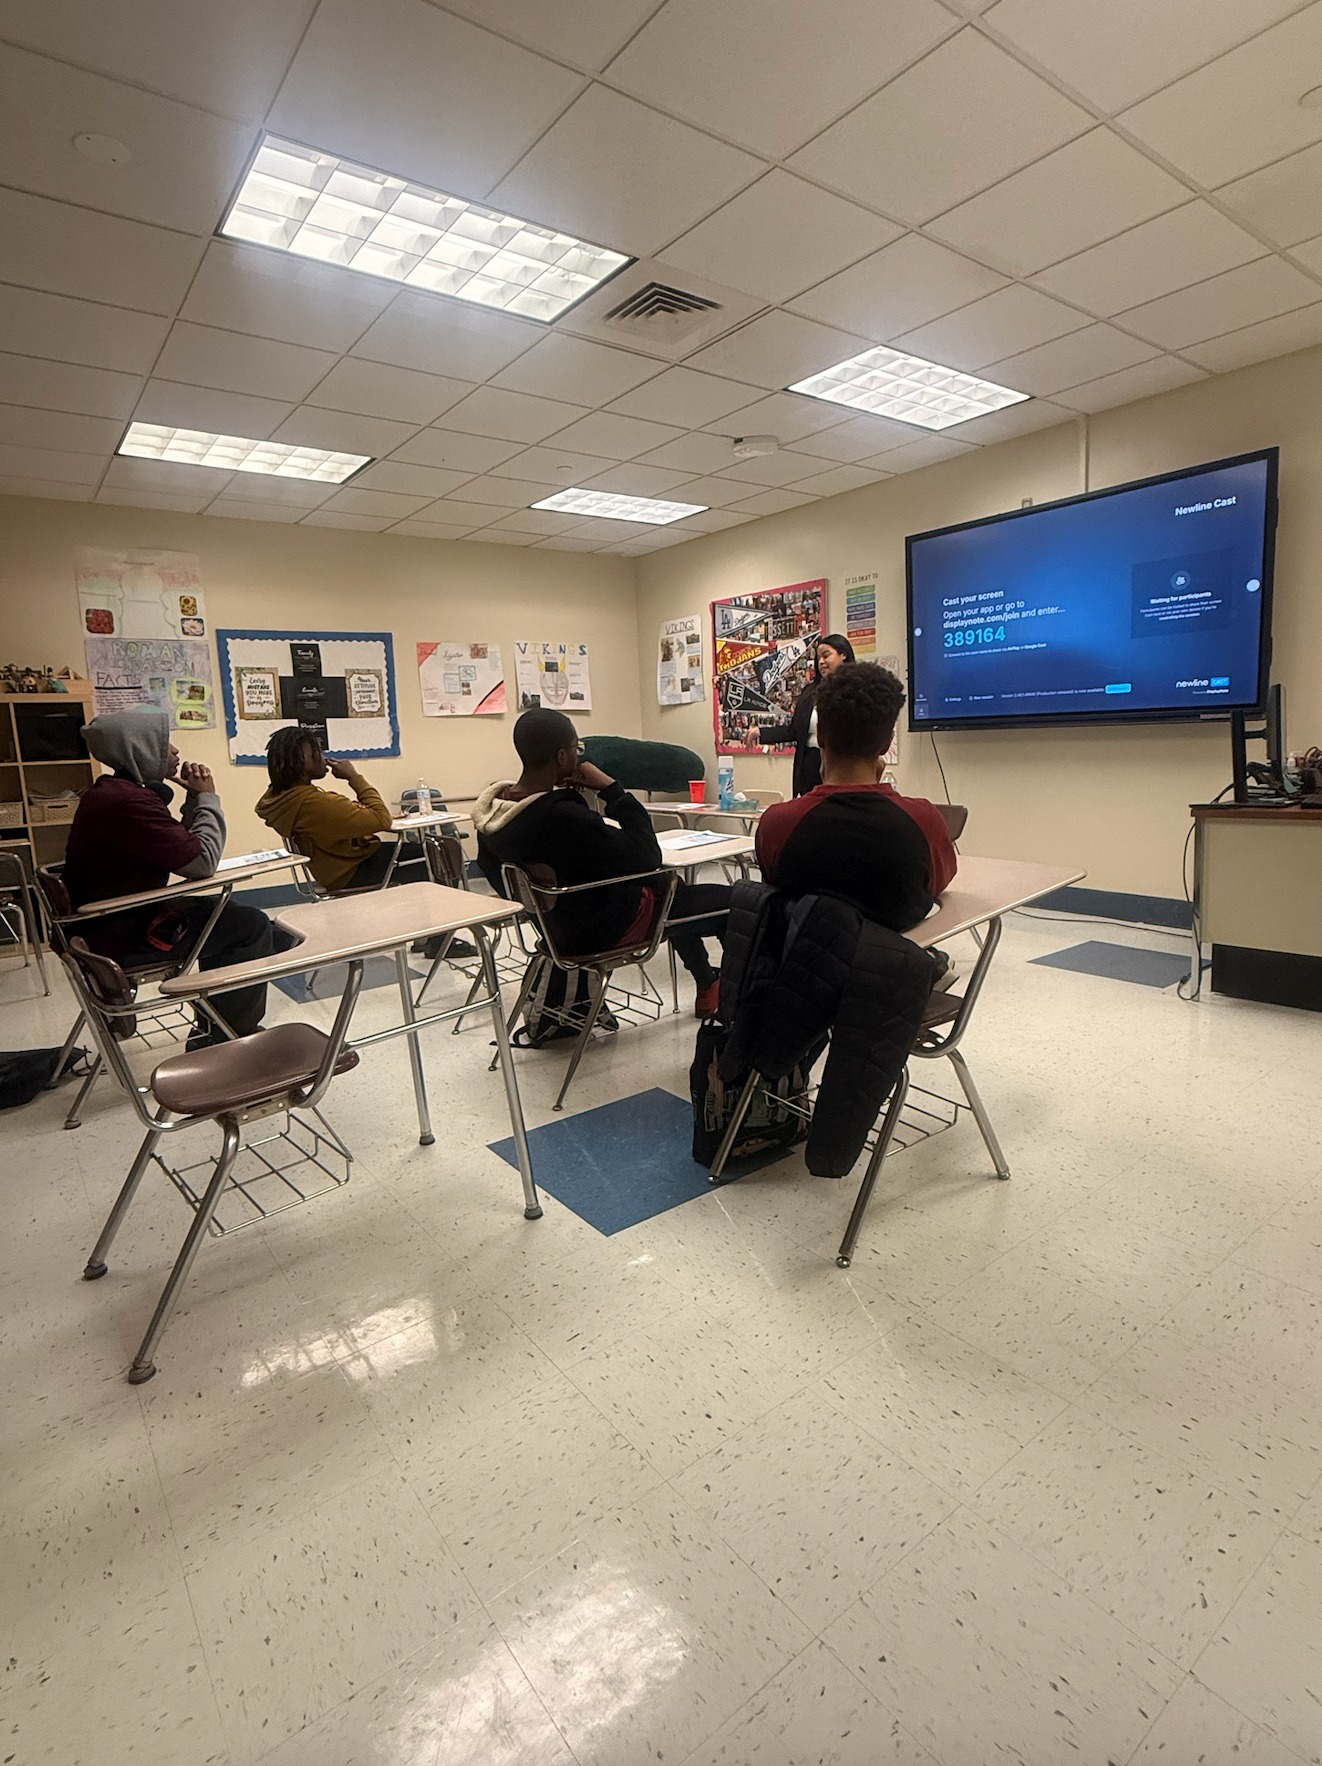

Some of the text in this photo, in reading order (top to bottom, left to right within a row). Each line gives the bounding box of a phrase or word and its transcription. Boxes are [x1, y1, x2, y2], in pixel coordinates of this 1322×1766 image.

[1175, 496, 1237, 516] Newline Cast
[943, 590, 1004, 606] Cast your screen
[943, 600, 1025, 620] Open your app or go to
[943, 605, 1066, 629] displaynote.com/join and enter...
[665, 619, 694, 634] VIKINGS
[943, 625, 1006, 648] 389164
[516, 642, 587, 656] VIKINGS
[719, 648, 762, 672] TROJANS
[96, 671, 141, 687] FACTS
[1175, 678, 1228, 688] newline CAST
